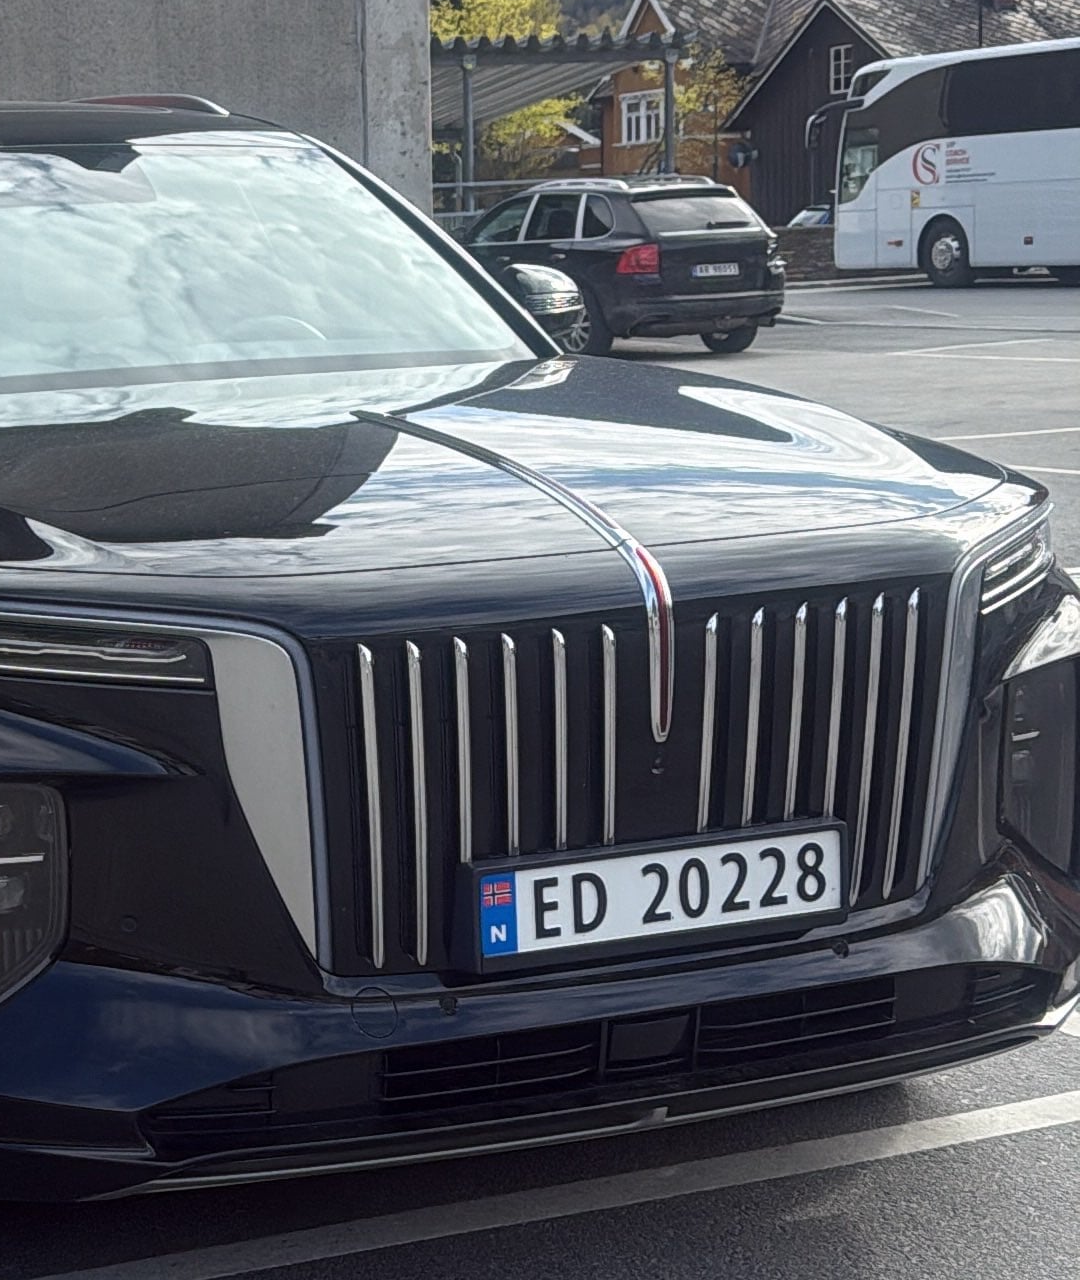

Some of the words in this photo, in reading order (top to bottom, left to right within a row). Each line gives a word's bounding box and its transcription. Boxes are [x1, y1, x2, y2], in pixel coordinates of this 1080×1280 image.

[532, 872, 608, 940] ED
[640, 842, 827, 924] 20228
[490, 924, 507, 943] N
